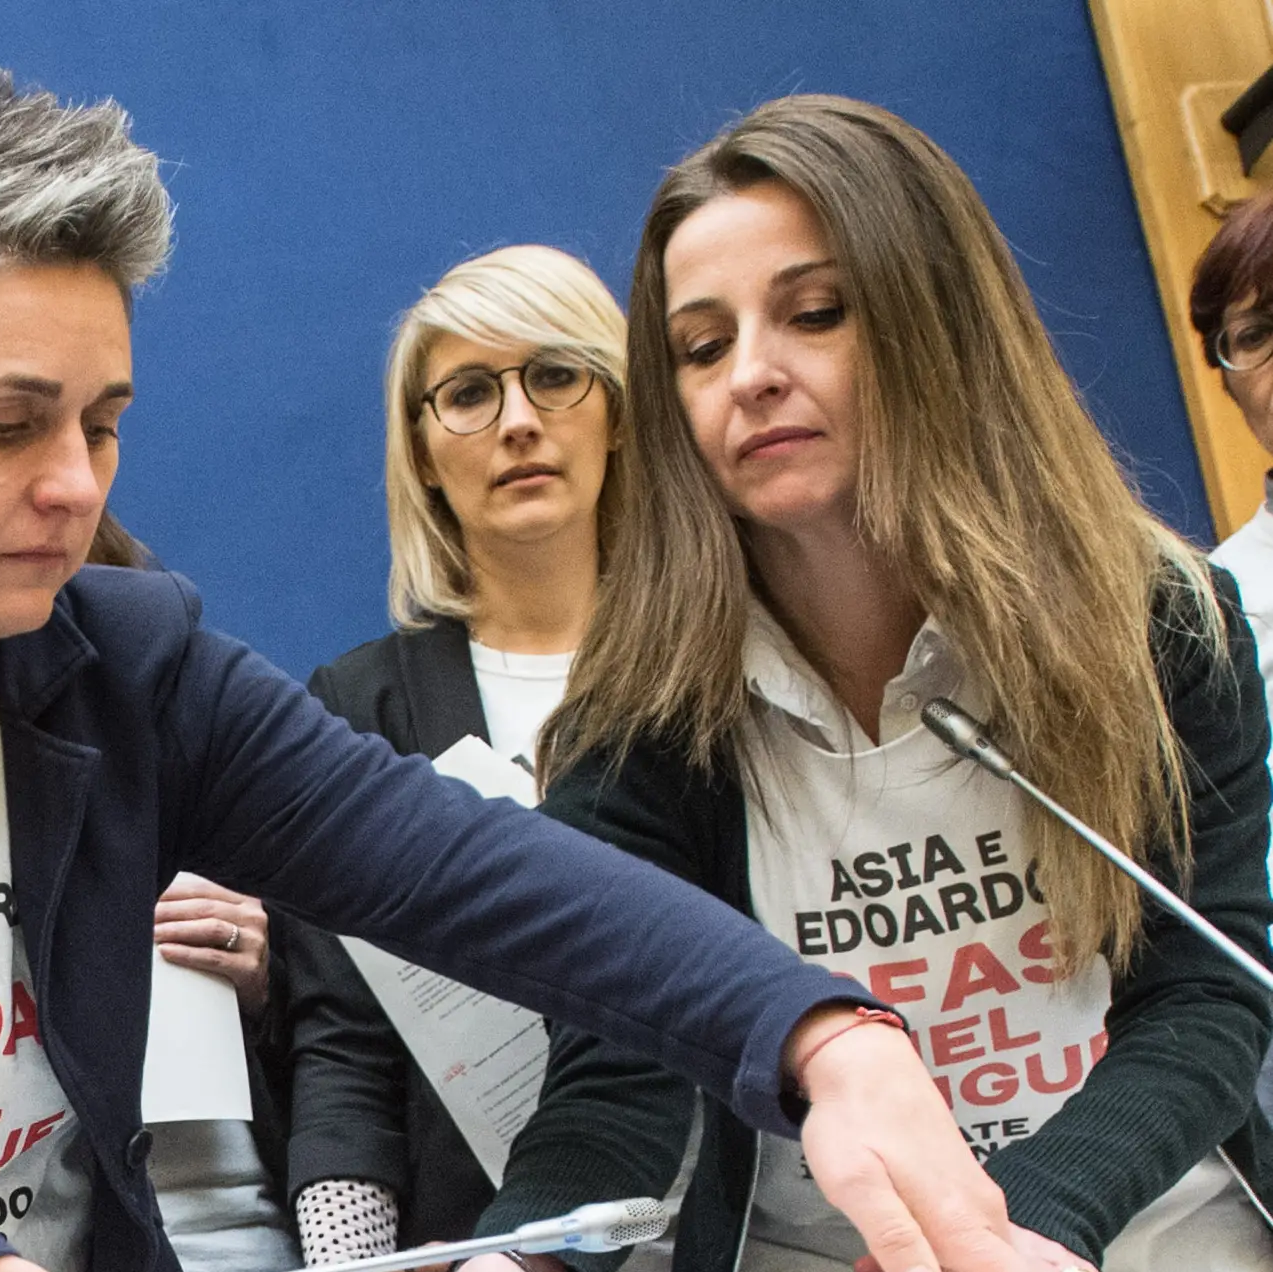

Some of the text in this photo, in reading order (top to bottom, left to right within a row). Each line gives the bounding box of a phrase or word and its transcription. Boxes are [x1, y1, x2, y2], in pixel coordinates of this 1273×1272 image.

[831, 831, 1008, 901] ASIA E
[830, 921, 1074, 1013] FAS
[932, 1031, 1109, 1107] GU
